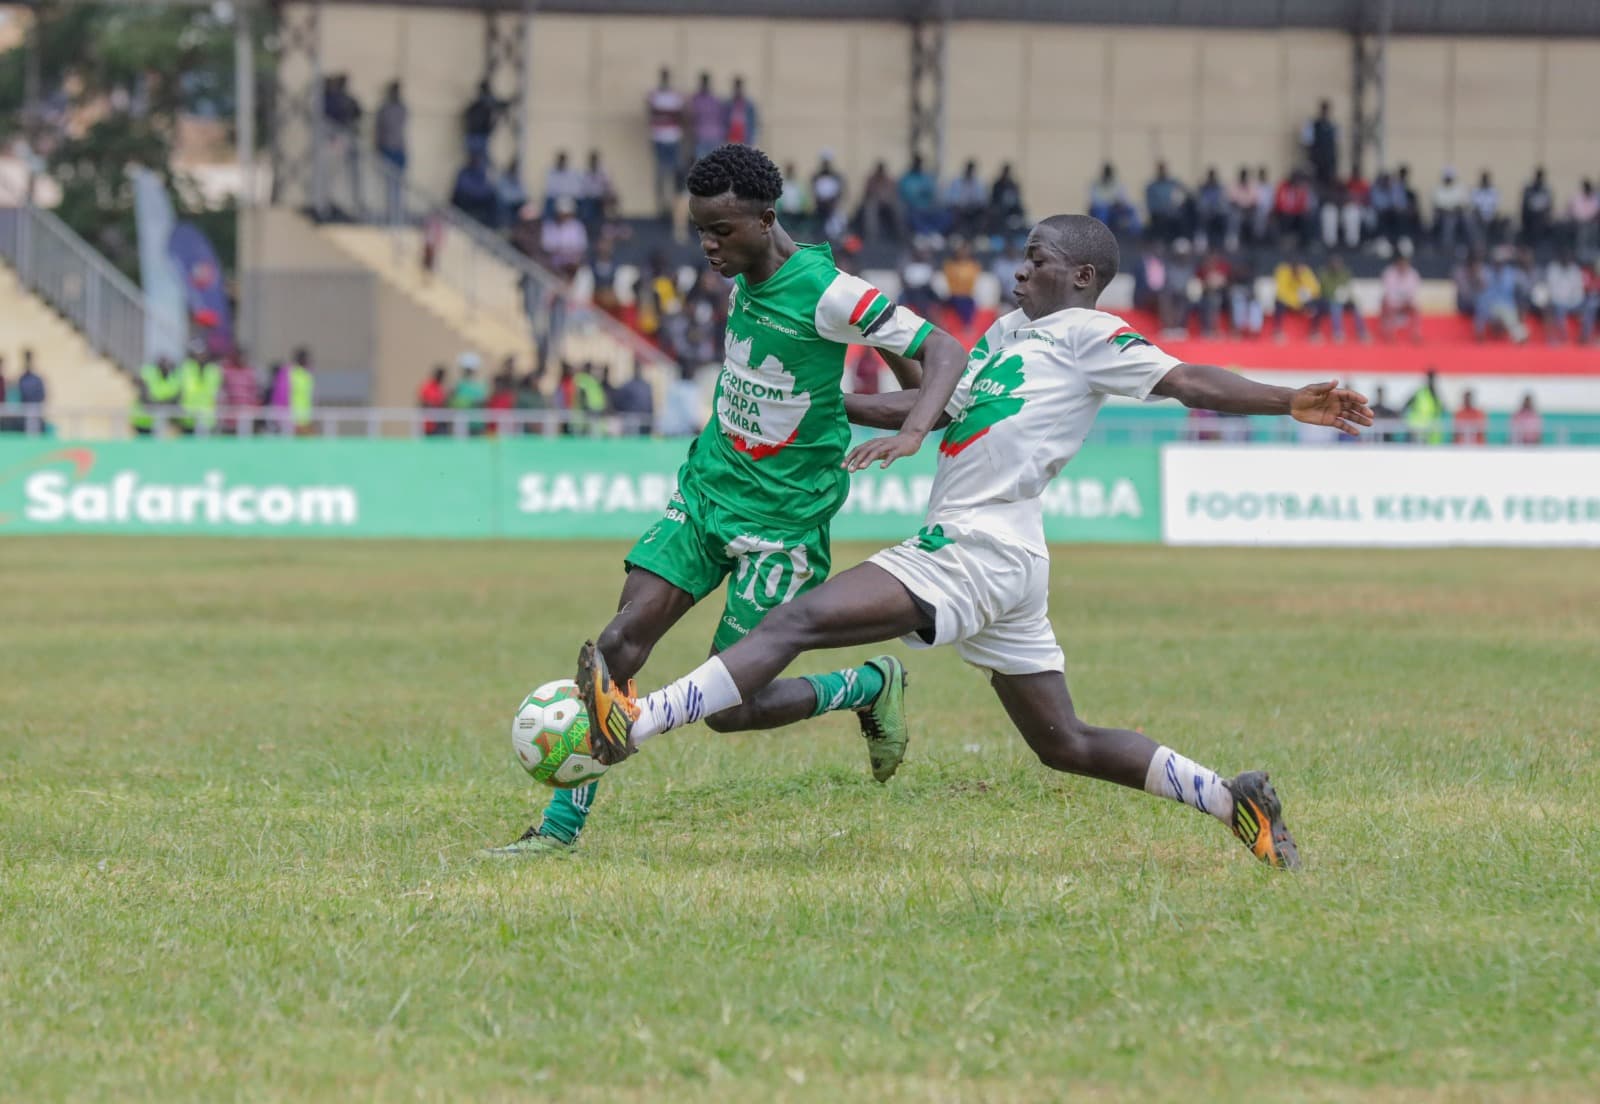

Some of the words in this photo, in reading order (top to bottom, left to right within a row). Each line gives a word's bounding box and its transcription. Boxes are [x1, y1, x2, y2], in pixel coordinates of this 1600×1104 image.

[25, 469, 357, 523] Safaricom
[841, 474, 936, 516] HAP
[1041, 478, 1143, 519] MBA
[1186, 490, 1363, 521] FOOTBALL
[1373, 493, 1494, 522] KENYA
[1503, 494, 1600, 524] FEDER
